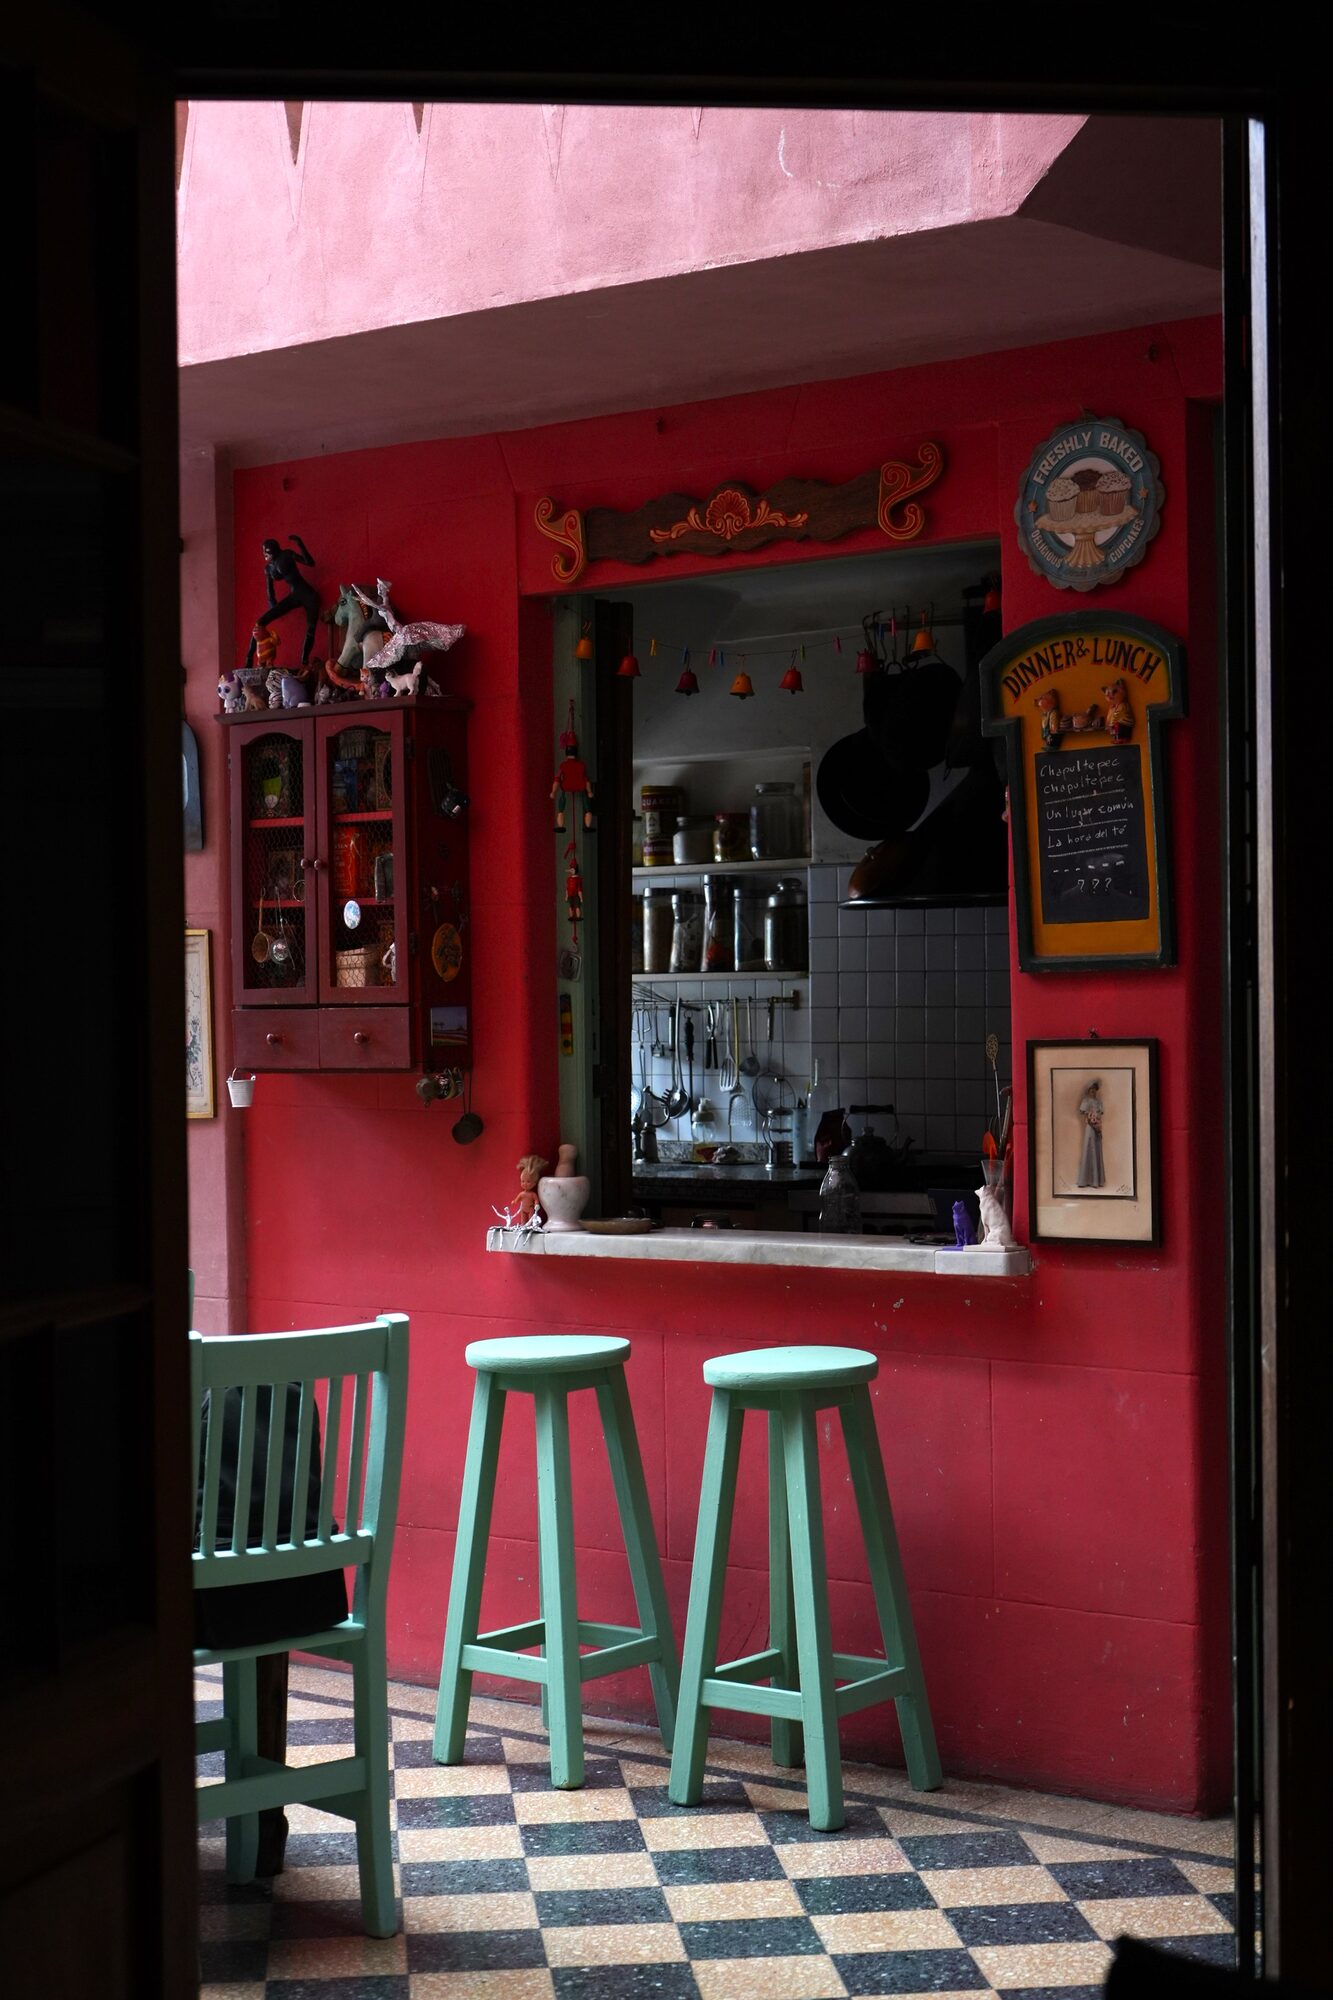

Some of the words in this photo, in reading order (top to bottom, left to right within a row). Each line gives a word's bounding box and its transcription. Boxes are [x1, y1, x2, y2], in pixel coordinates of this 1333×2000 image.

[1032, 431, 1093, 486] FRESHLY
[1099, 431, 1145, 473] BAKED
[1031, 529, 1064, 569] DELICIOUS
[1109, 518, 1145, 563] CUPCAKES
[1092, 637, 1163, 684] LUNCH
[1040, 758, 1121, 781] Chapultepec
[1046, 809, 1062, 821] Un
[1065, 806, 1094, 823] lugar
[1097, 796, 1134, 815] común
[1047, 834, 1063, 849] La
[1067, 833, 1092, 845] hora
[1094, 827, 1108, 840] del
[1111, 824, 1127, 837] té
